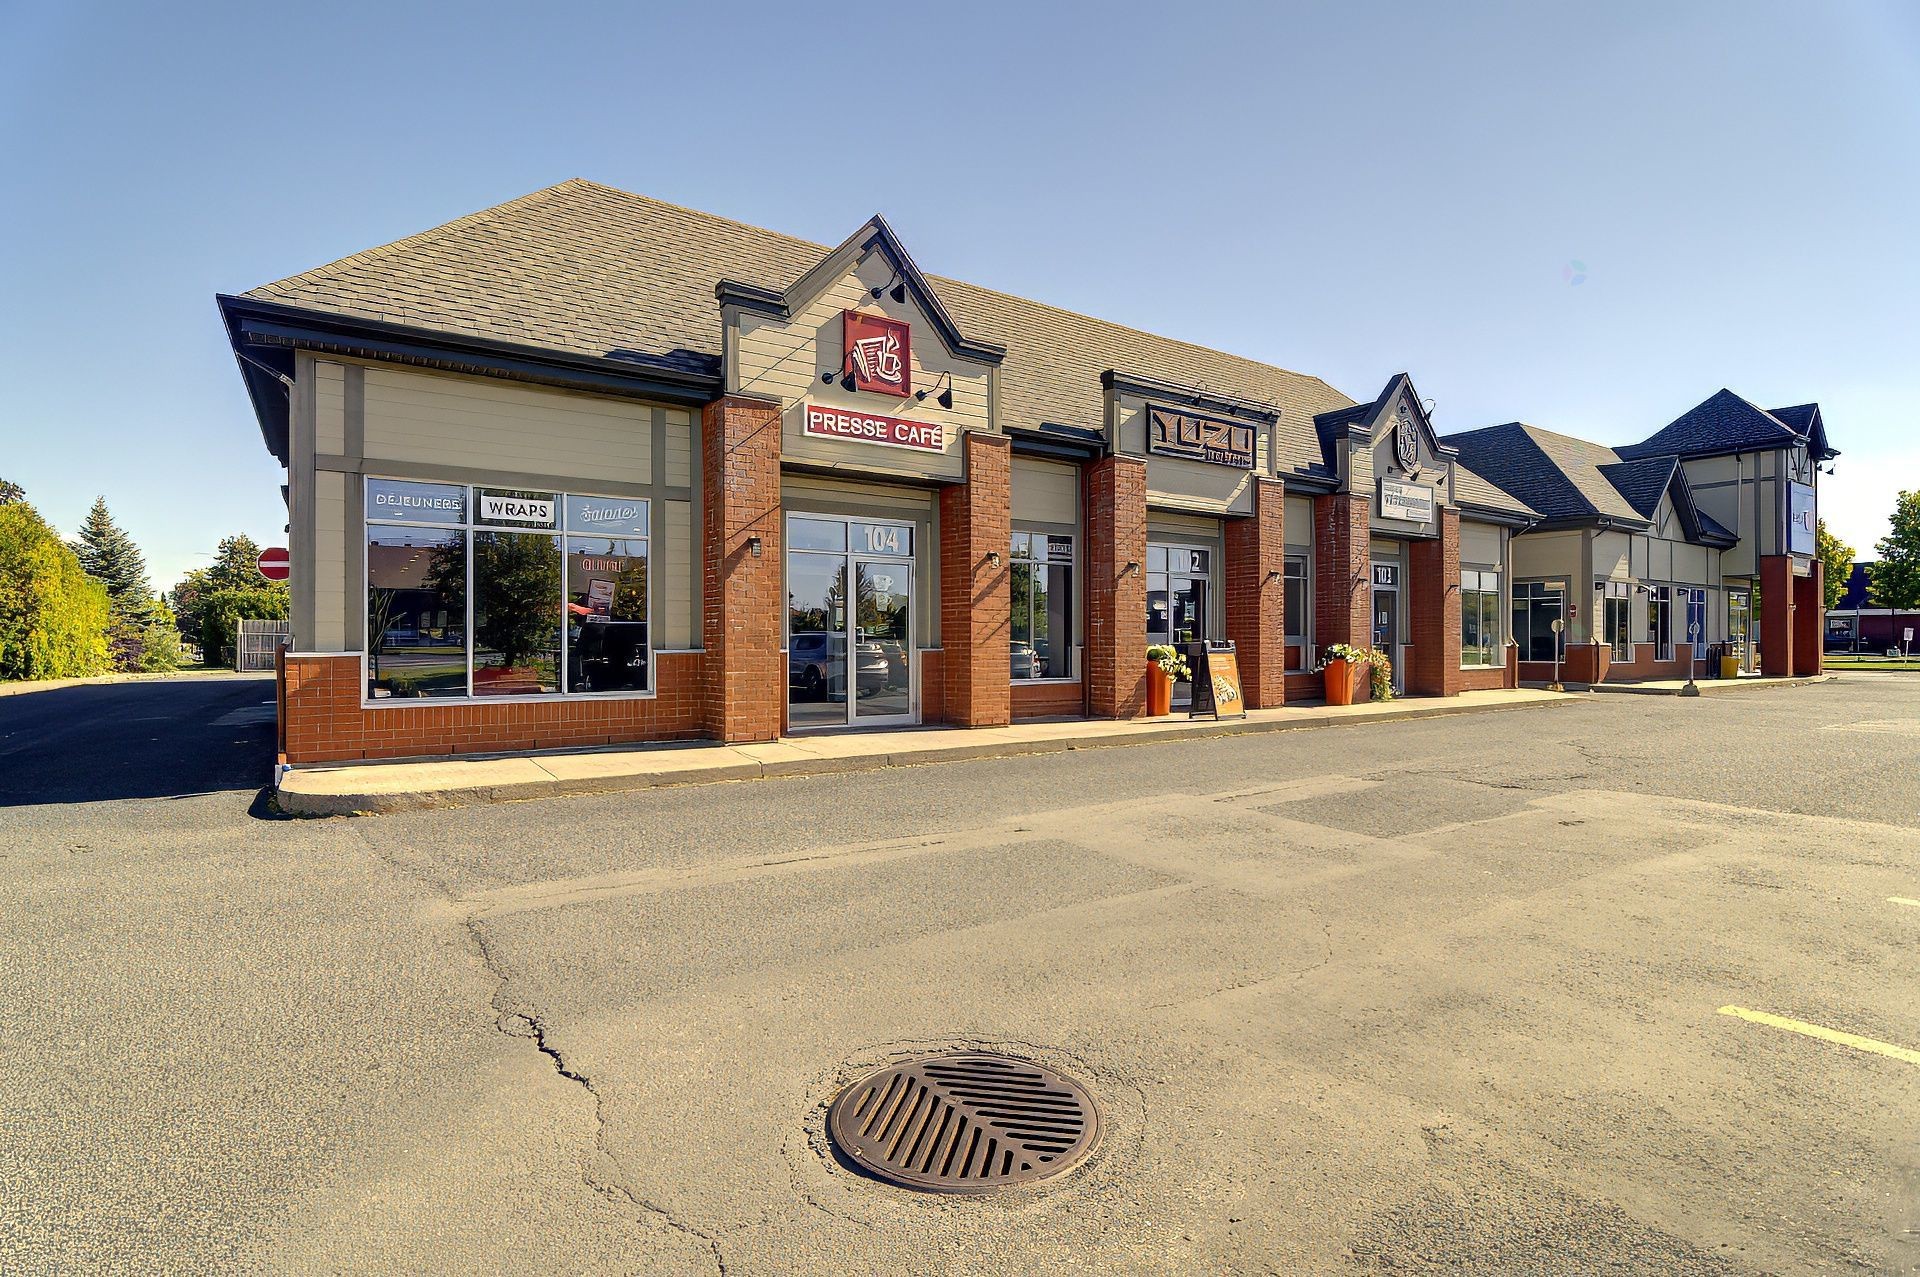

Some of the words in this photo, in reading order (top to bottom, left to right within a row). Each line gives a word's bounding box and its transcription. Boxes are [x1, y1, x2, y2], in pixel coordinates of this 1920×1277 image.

[809, 411, 888, 439] PRESSE
[894, 423, 943, 447] CAFÉ
[1152, 409, 1253, 453] YUZU
[489, 501, 548, 518] WRAPS
[864, 526, 900, 552] 104
